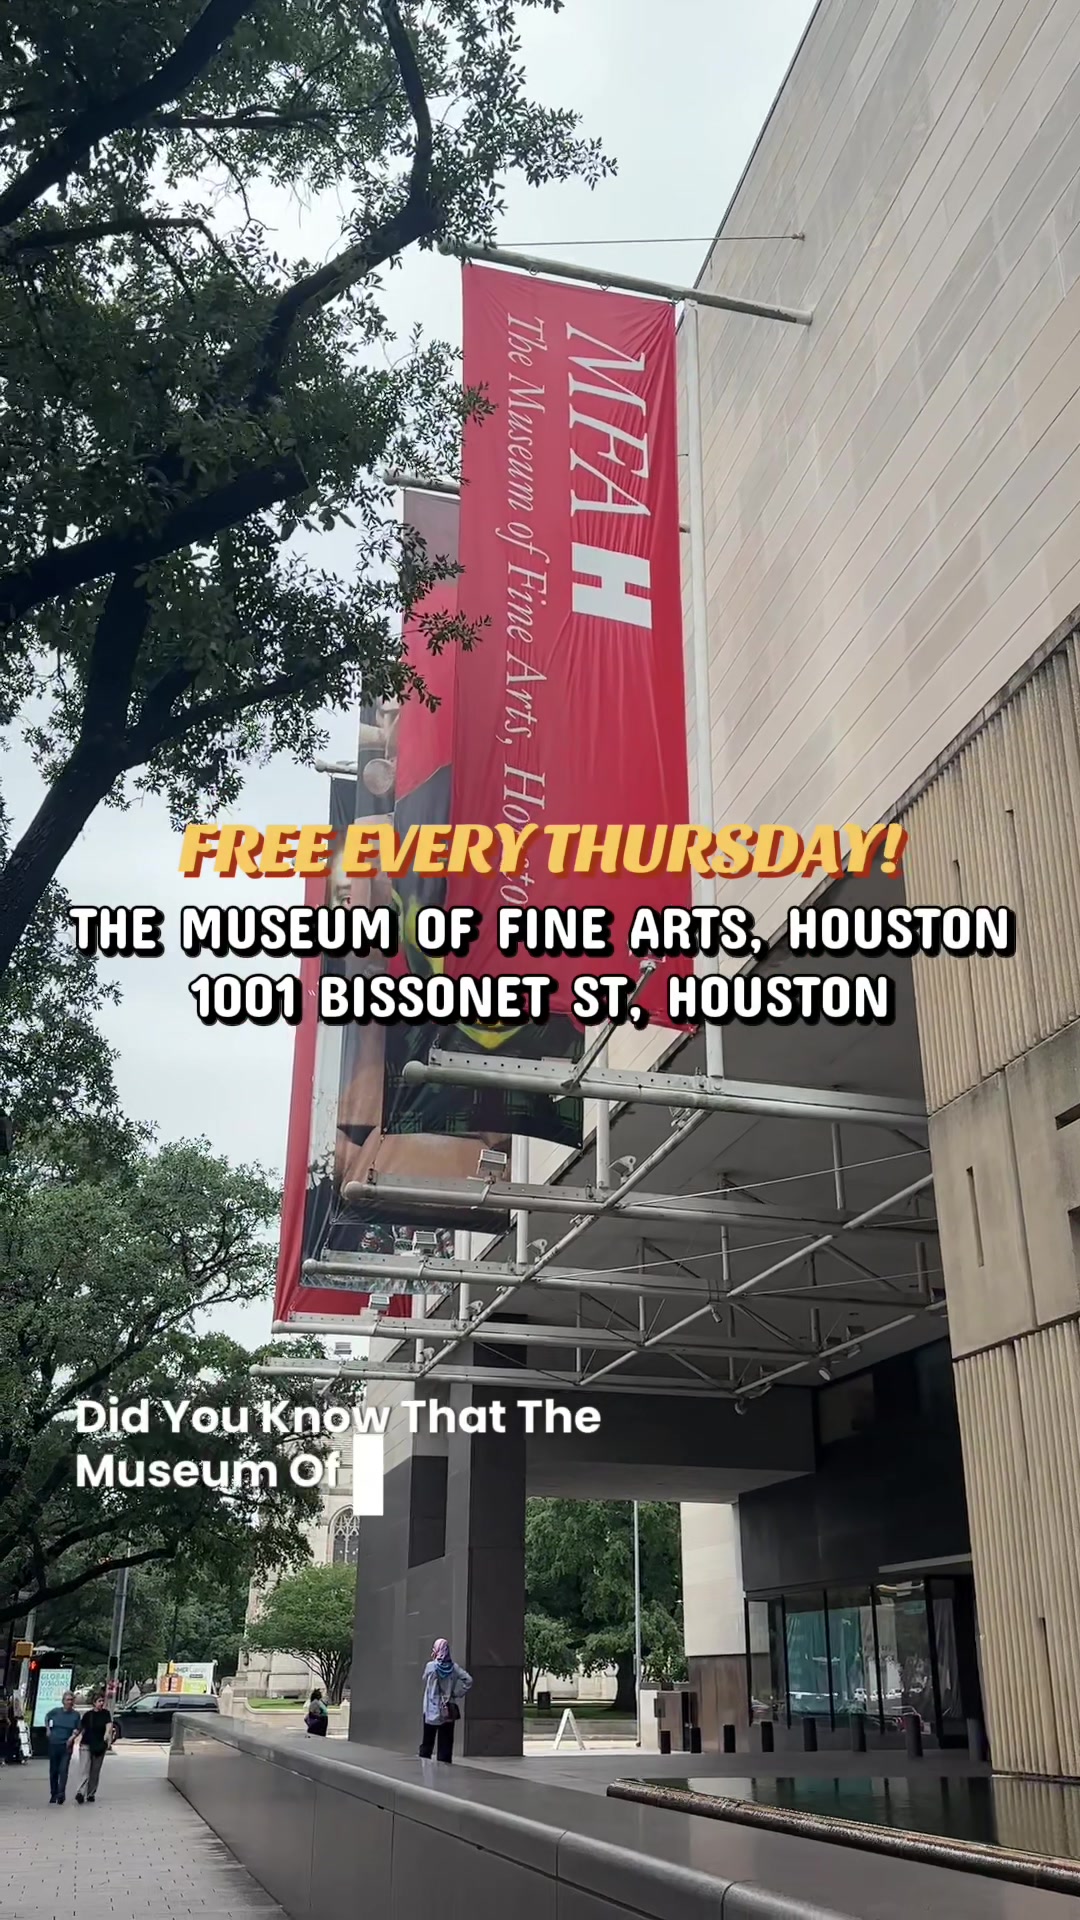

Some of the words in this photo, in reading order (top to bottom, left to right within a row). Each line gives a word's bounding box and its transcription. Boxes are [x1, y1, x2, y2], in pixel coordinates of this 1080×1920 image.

[506, 312, 548, 368] The
[507, 372, 546, 512] Museum
[566, 321, 653, 630] MFAH
[495, 520, 550, 564] of
[506, 560, 548, 645] Fine
[495, 649, 548, 745] Arts,
